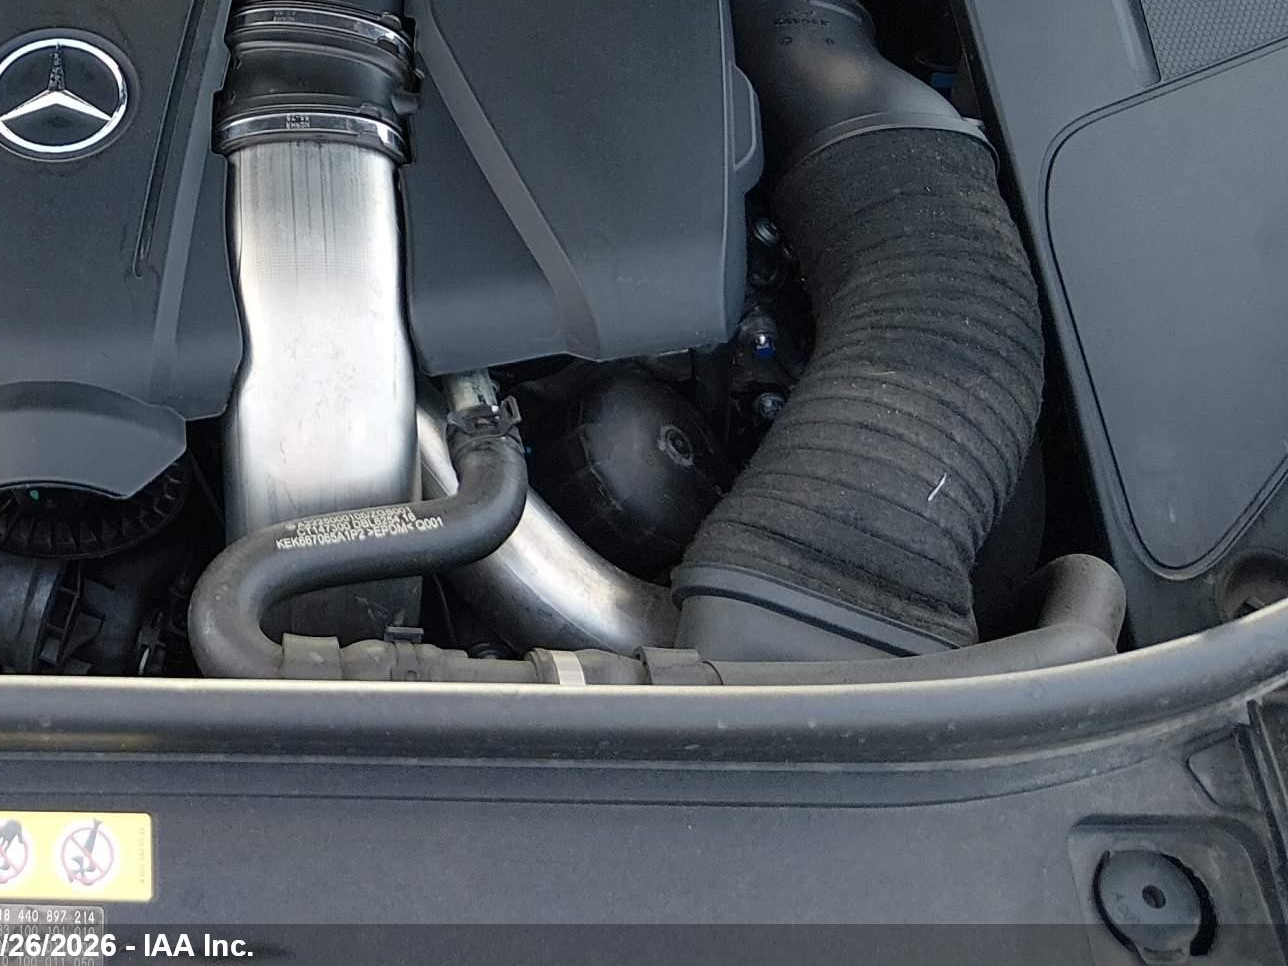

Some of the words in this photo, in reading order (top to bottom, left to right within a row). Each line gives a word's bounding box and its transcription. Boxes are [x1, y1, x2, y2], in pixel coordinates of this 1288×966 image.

[18, 909, 39, 922] 440
[46, 910, 67, 922] 897
[74, 910, 95, 924] 214
